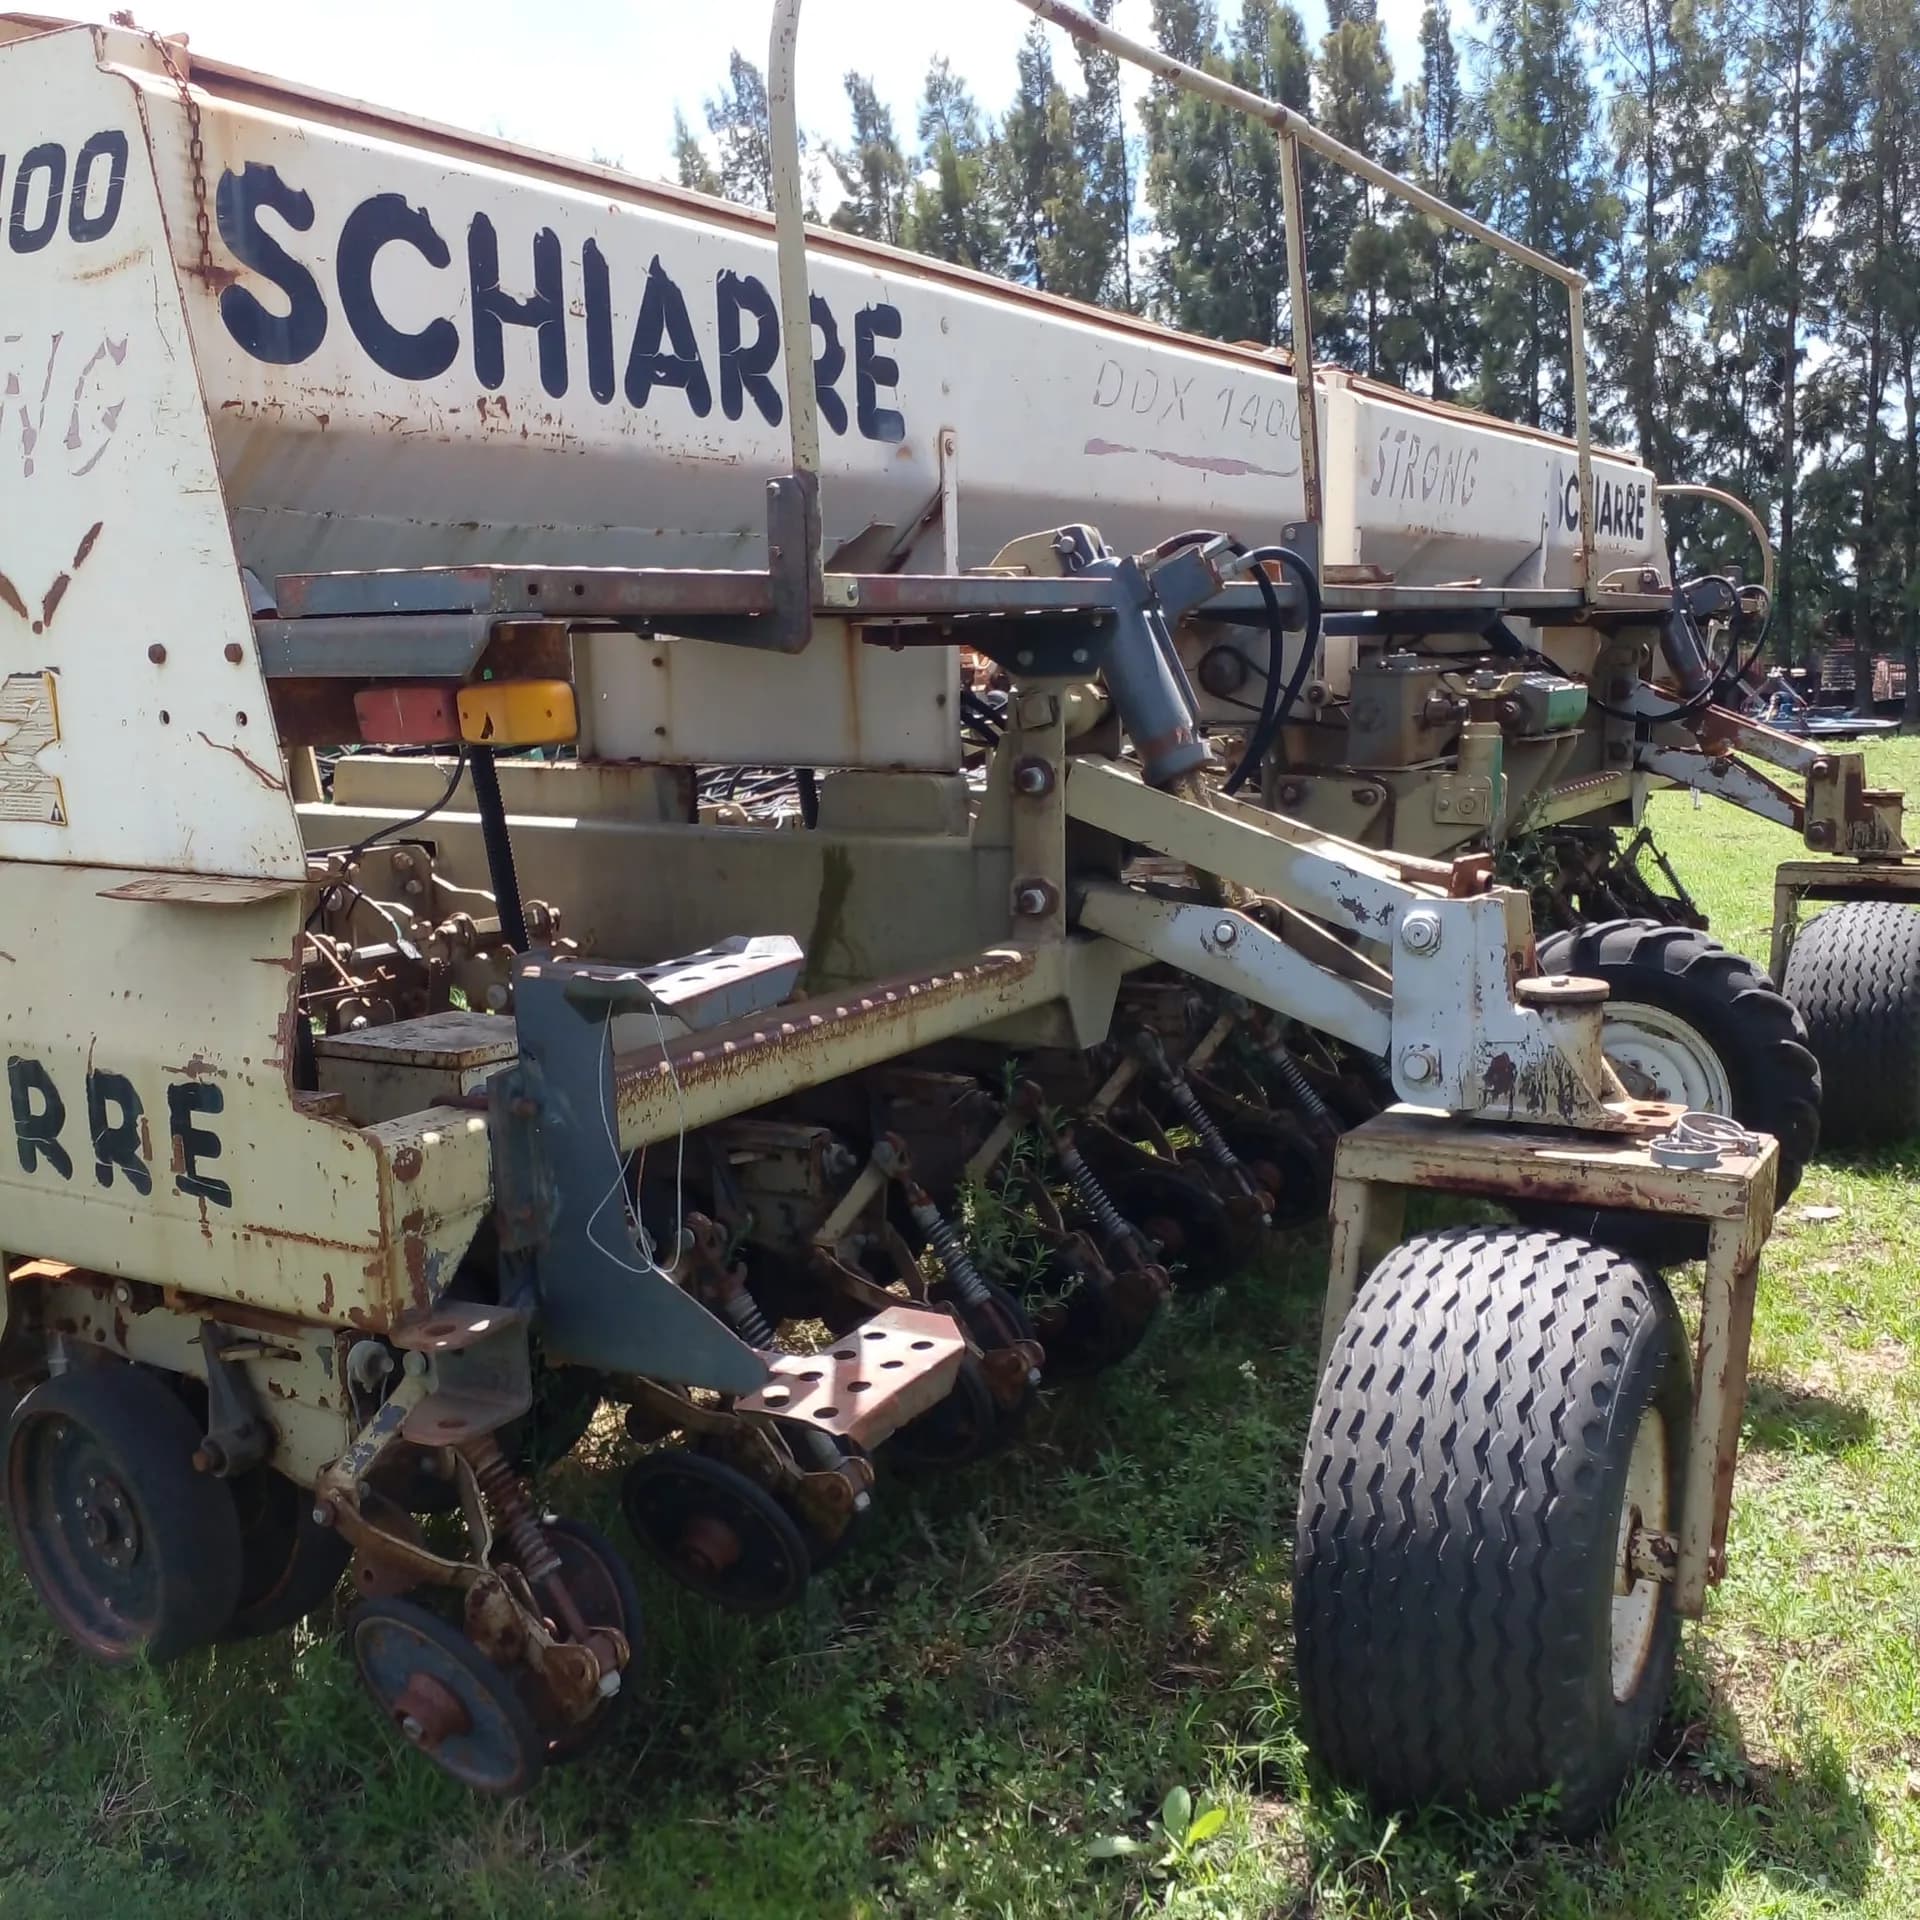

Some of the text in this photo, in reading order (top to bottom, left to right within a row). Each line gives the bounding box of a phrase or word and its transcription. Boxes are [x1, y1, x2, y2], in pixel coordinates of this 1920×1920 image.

[0, 129, 129, 254] 00
[216, 161, 905, 443] SCHIARRE
[1093, 359, 1194, 421] DDX
[1371, 426, 1479, 507] STRONG
[1551, 467, 1645, 540] SCIARRE
